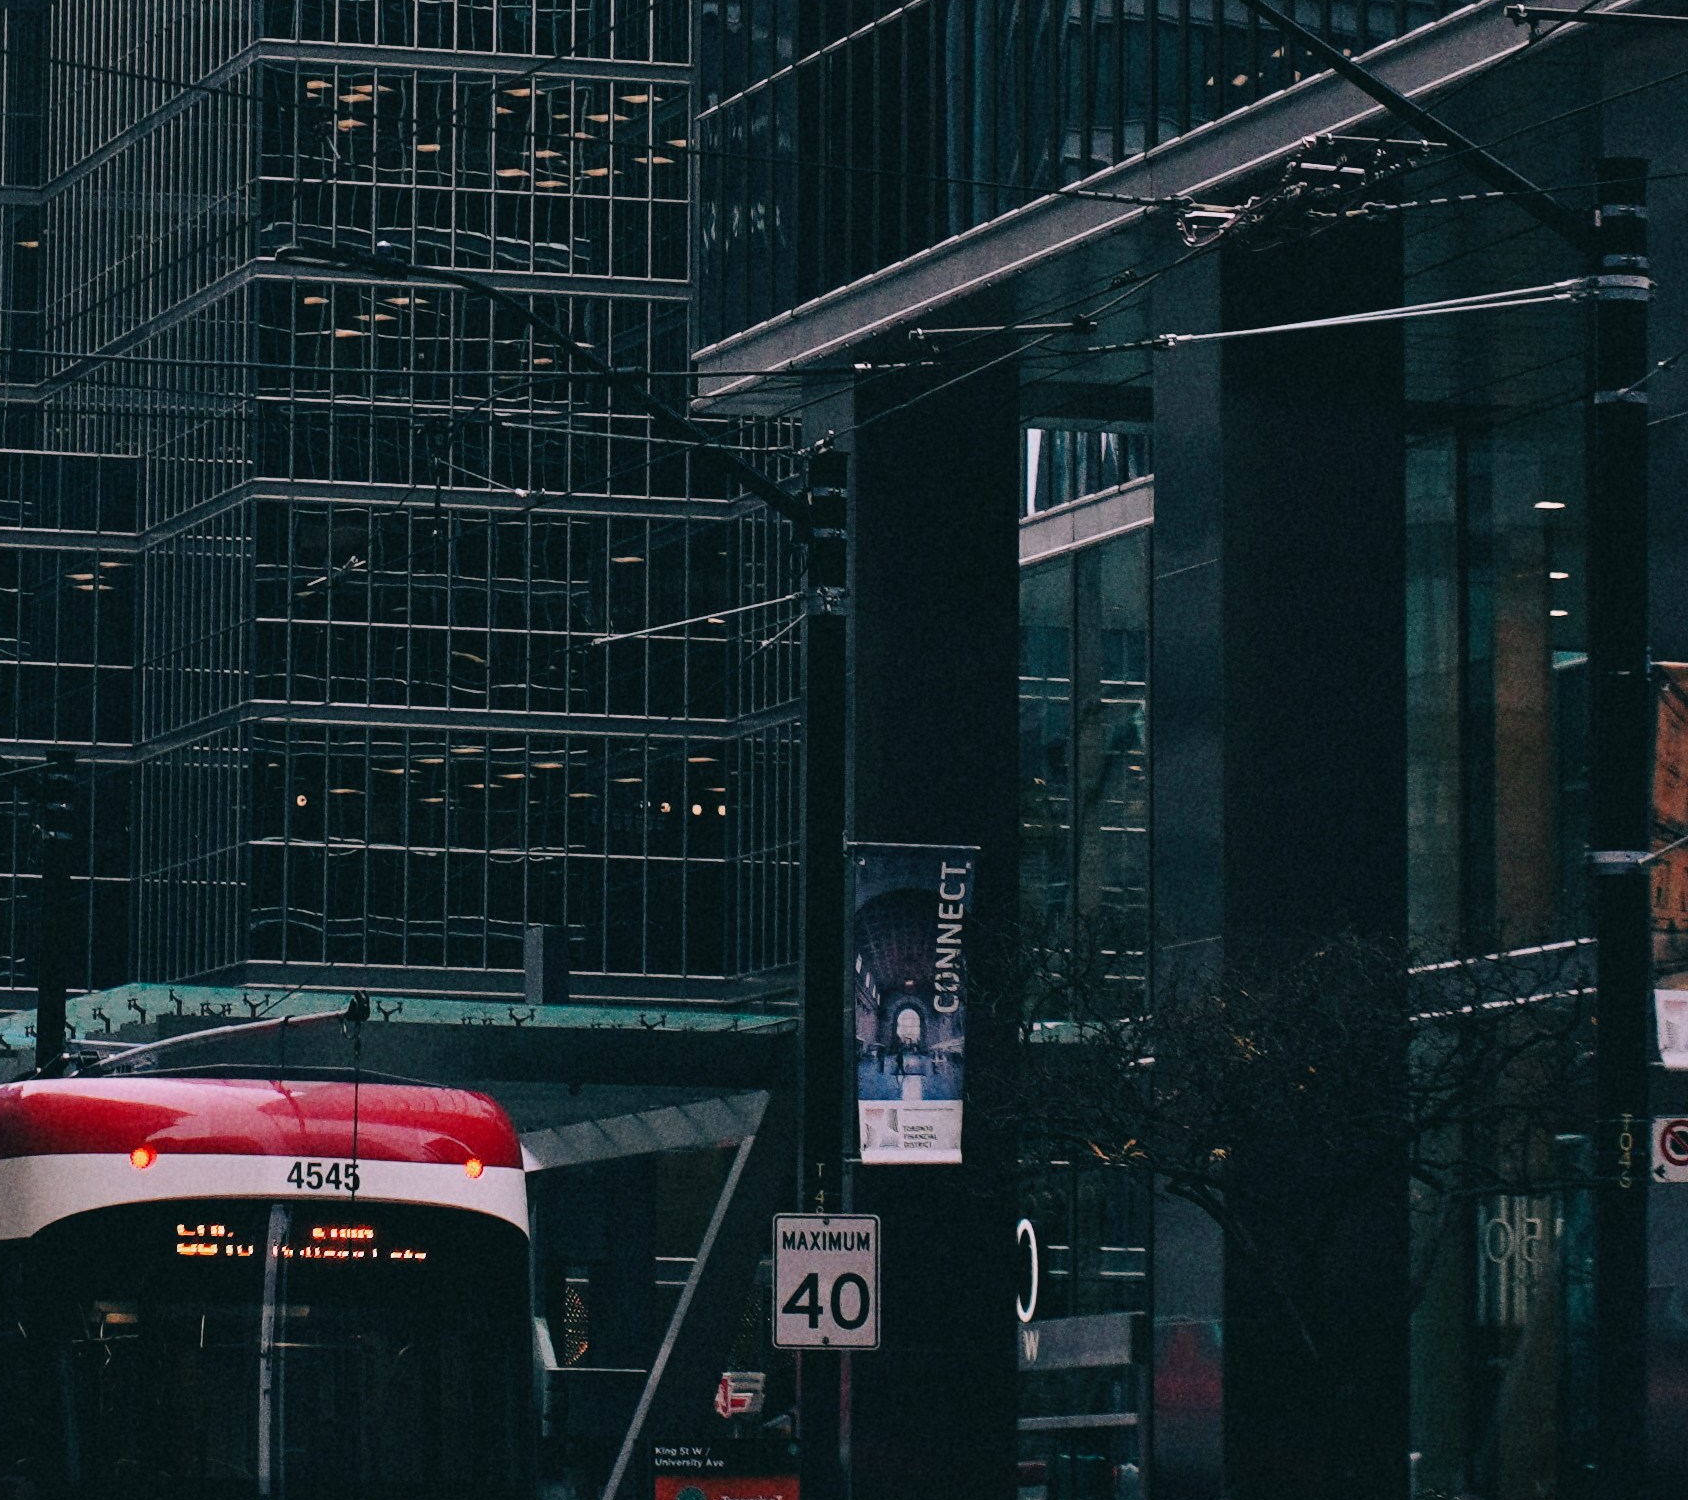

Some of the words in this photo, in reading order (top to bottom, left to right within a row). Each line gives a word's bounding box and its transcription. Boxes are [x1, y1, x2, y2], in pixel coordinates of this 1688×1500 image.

[287, 1161, 361, 1192] 4545
[781, 1231, 871, 1251] MAXIMUM
[781, 1272, 871, 1331] 40
[1022, 1330, 1040, 1362] W
[655, 1447, 677, 1456] King
[680, 1447, 690, 1455] St
[692, 1447, 703, 1455] W
[655, 1459, 703, 1468] University
[705, 1459, 725, 1467] Ave
